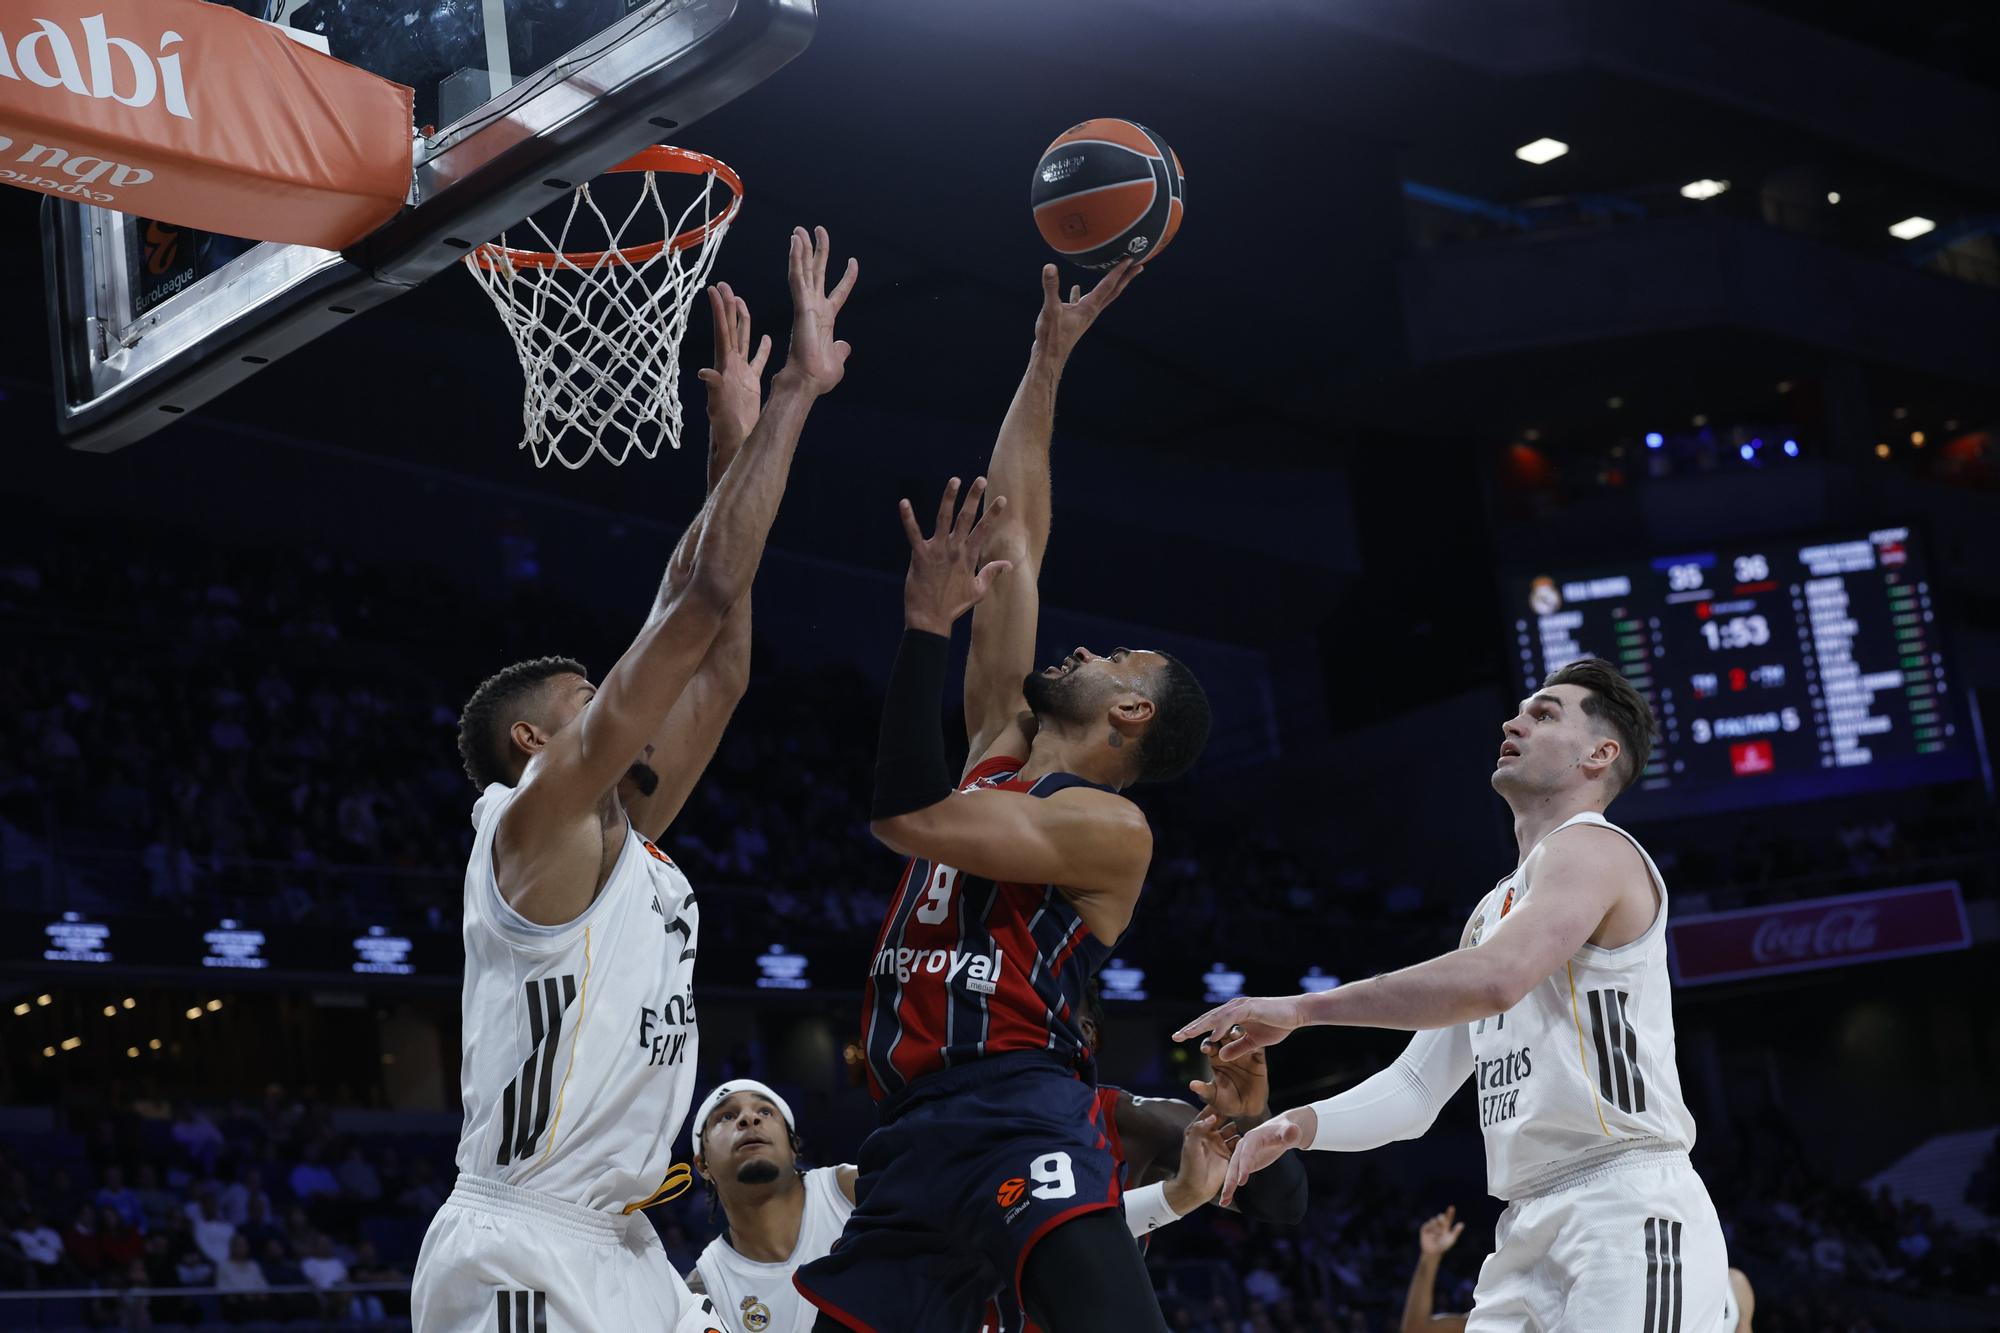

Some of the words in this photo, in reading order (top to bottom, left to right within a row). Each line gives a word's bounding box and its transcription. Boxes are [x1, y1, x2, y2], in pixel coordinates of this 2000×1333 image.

[16, 143, 153, 187] abu
[136, 268, 194, 311] EuroLeague
[1701, 614, 1770, 650] 1:53
[916, 863, 958, 925] 9
[1029, 1151, 1077, 1200] 9
